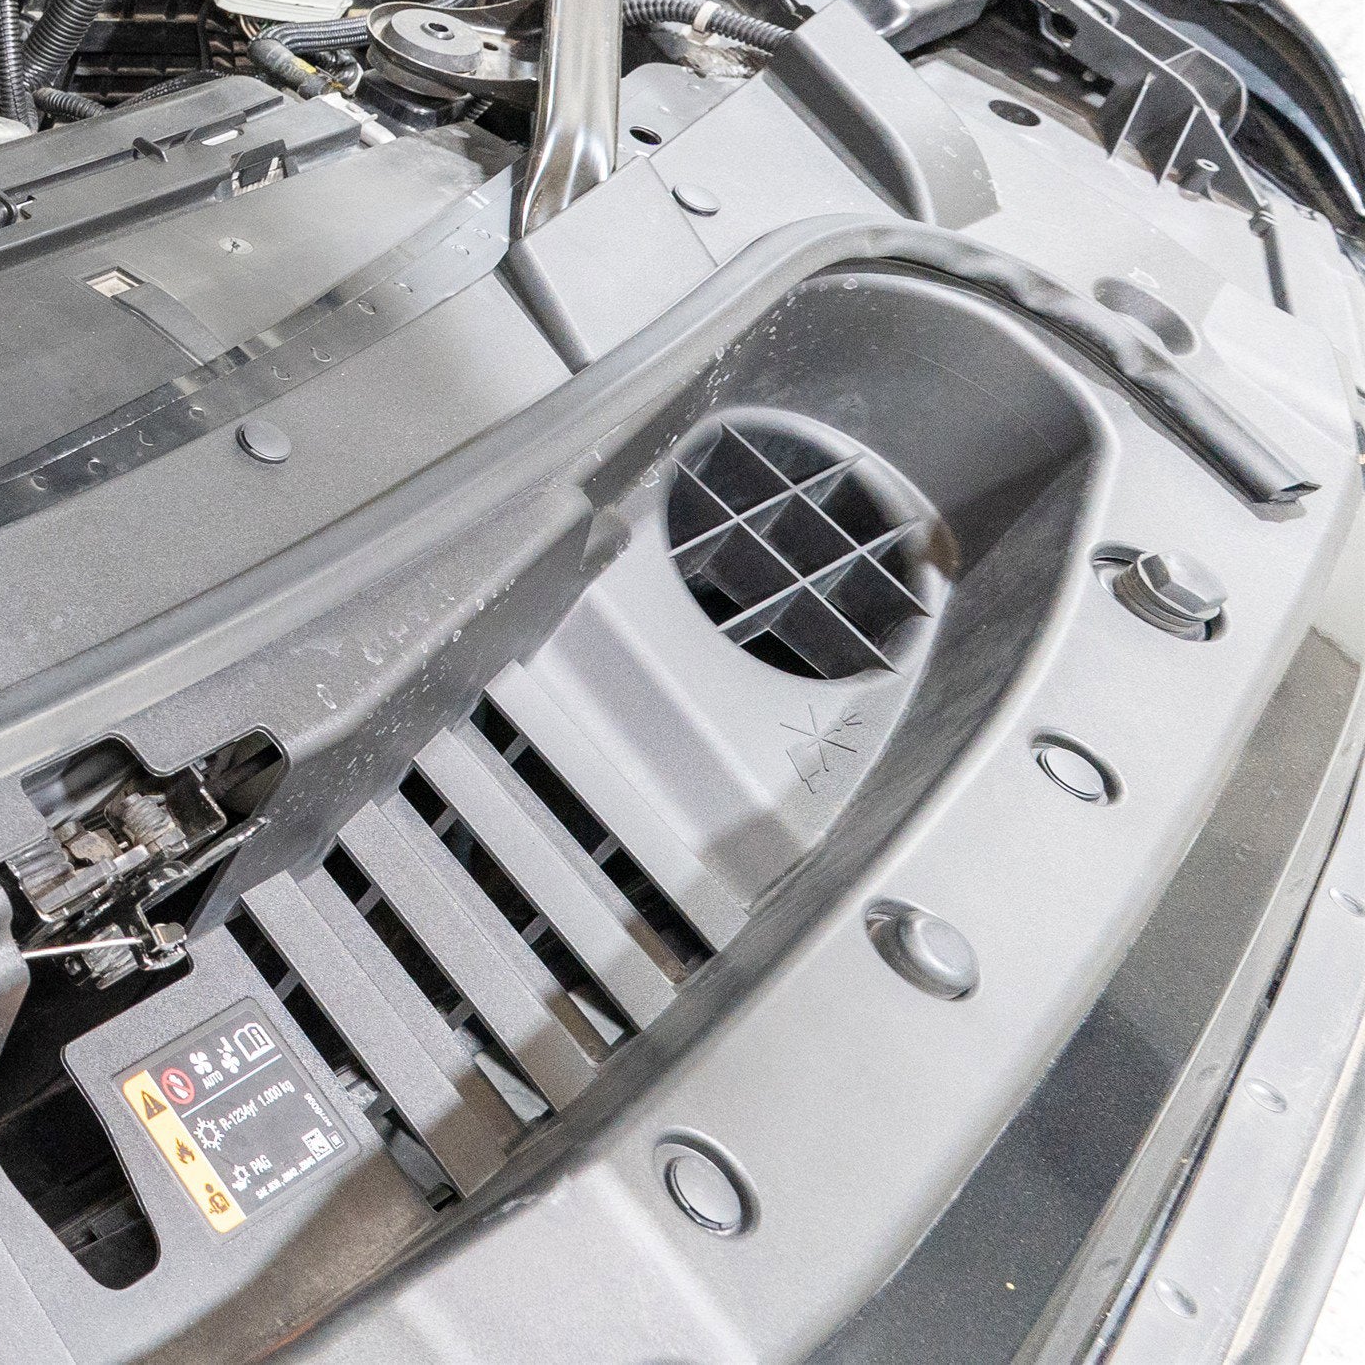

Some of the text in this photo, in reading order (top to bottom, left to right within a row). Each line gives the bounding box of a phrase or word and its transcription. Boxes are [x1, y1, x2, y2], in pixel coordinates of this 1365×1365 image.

[201, 1070, 224, 1090] AUTO
[219, 1079, 295, 1131] R-1234yf 1.000 kg
[249, 1154, 273, 1176] PAG
